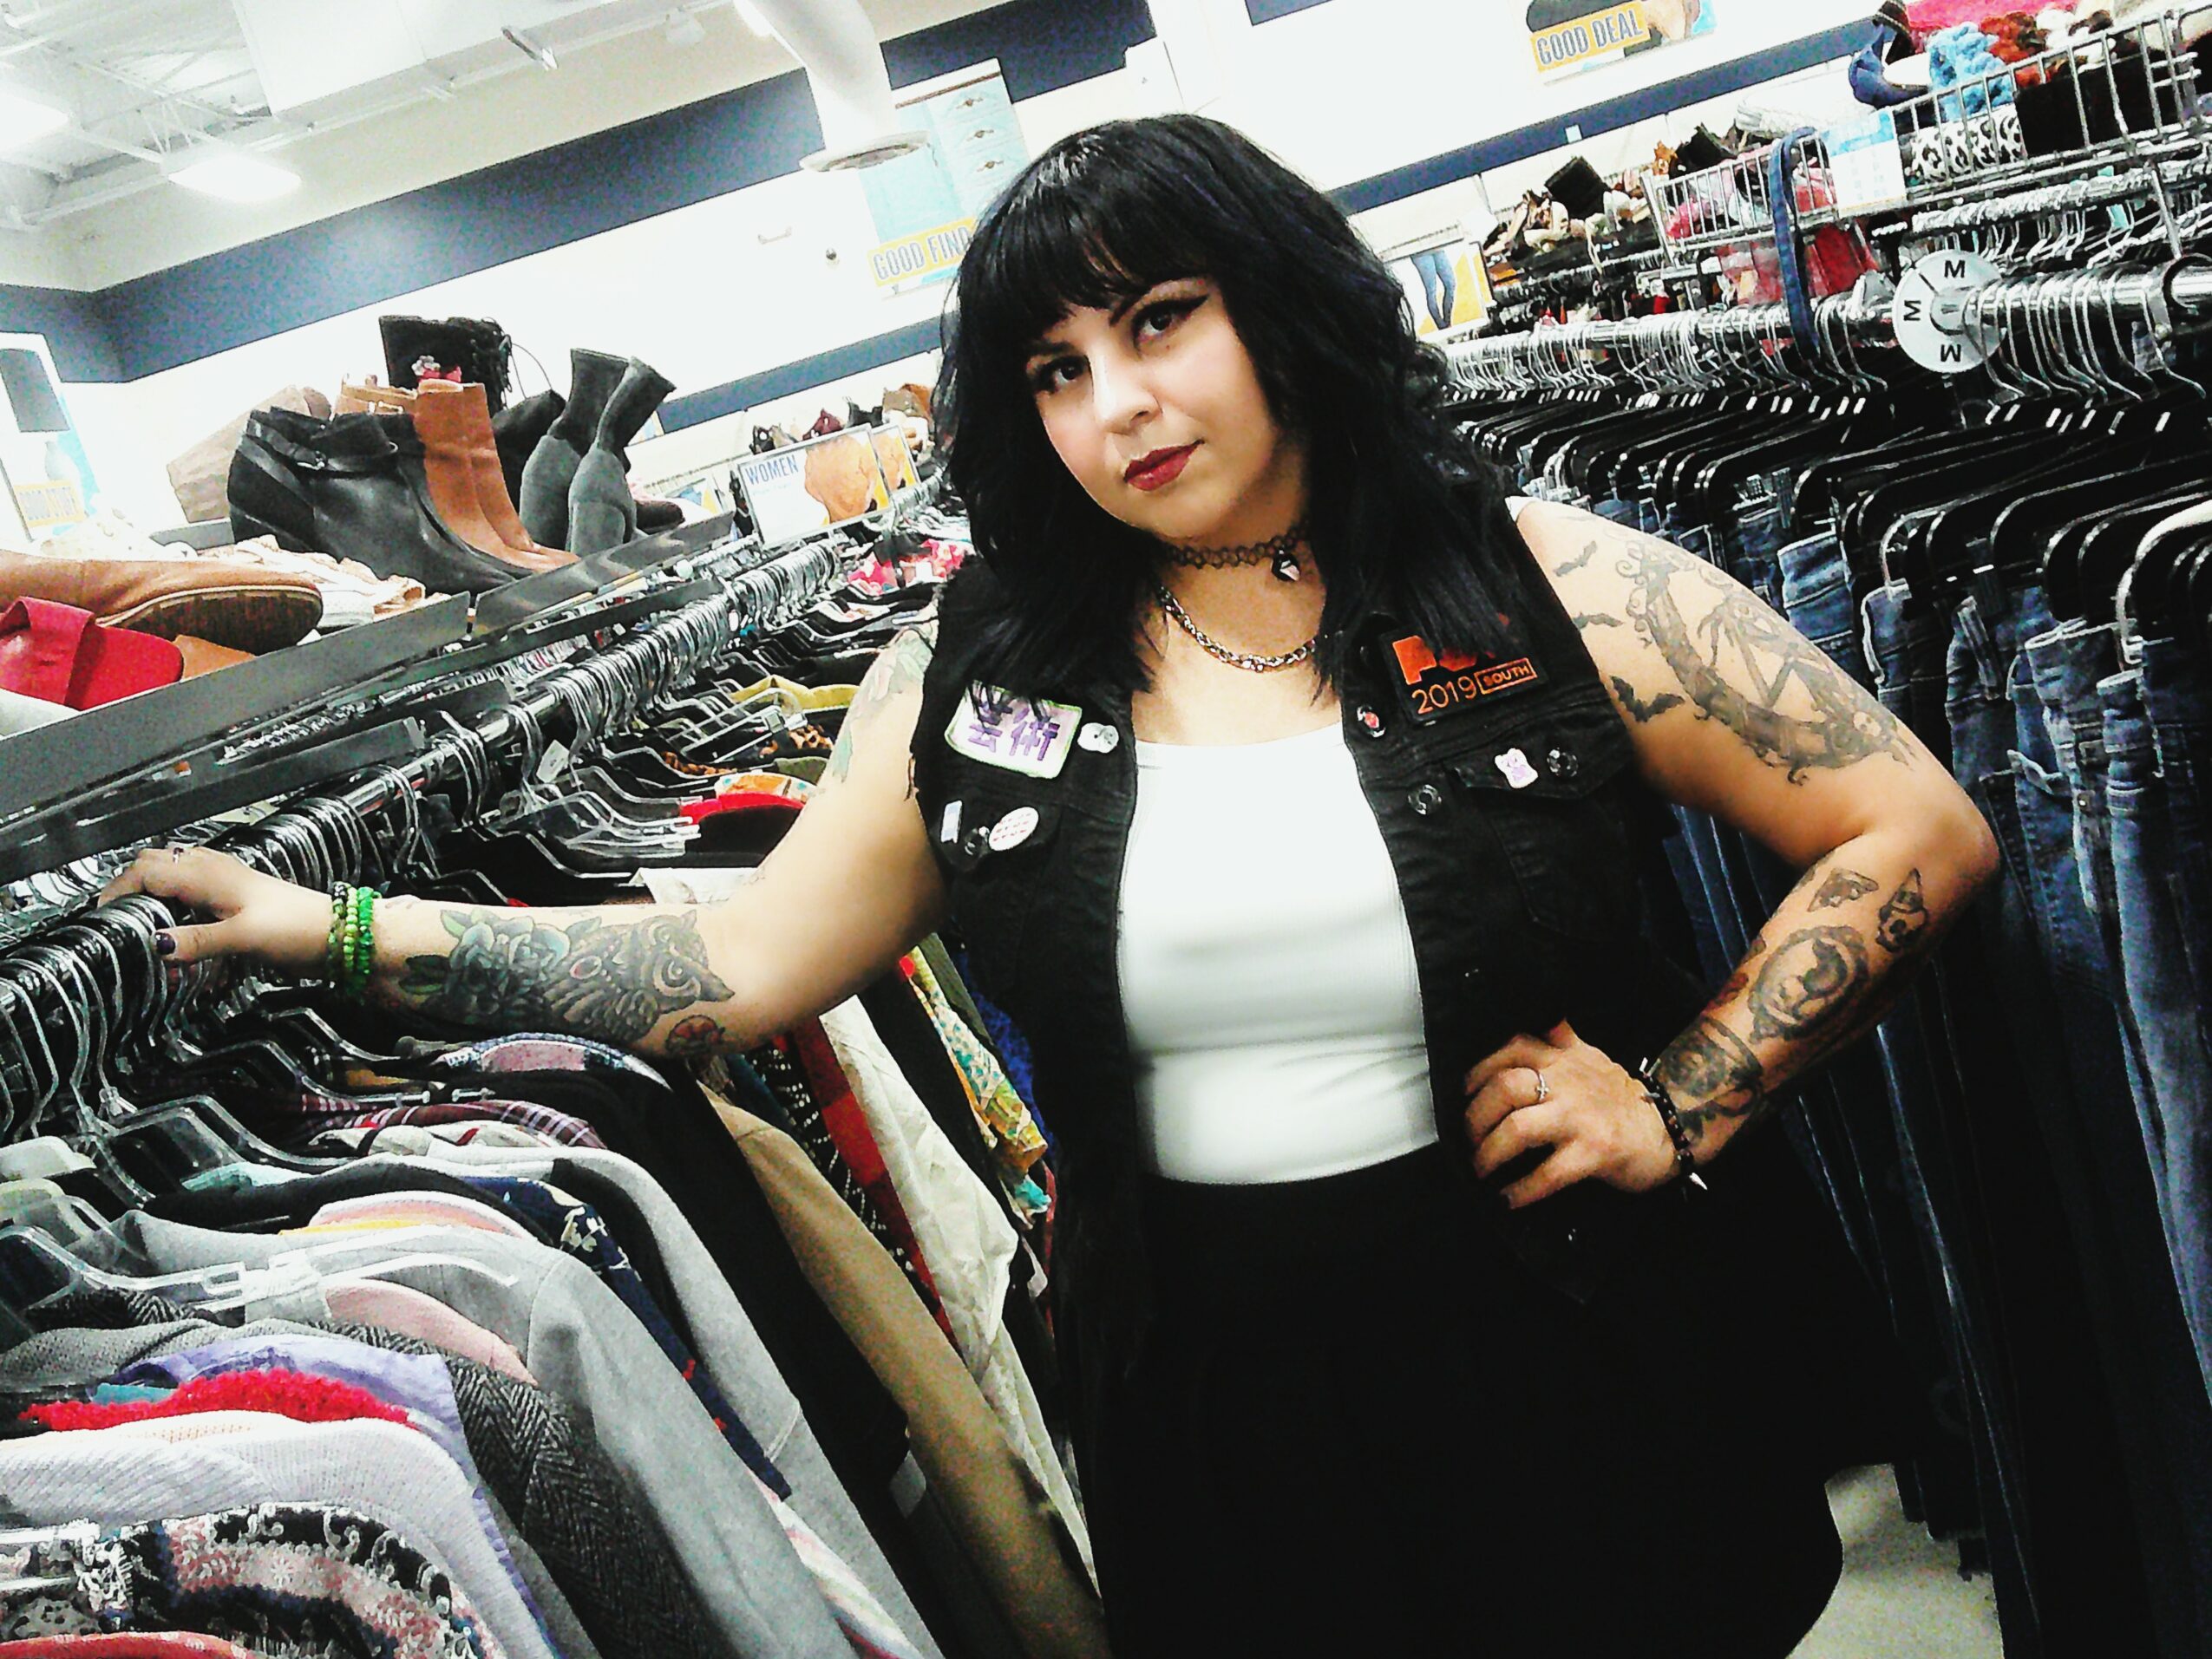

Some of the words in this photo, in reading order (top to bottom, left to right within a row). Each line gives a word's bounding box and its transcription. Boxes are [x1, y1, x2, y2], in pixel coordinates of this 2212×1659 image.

[1536, 26, 1589, 65] GOOD
[1592, 10, 1643, 48] DEAL
[873, 242, 925, 280] GOOD
[1944, 259, 1966, 278] M
[745, 454, 799, 485] WOMEN
[1411, 676, 1476, 715] 2019
[1482, 664, 1529, 687] SOUTH
